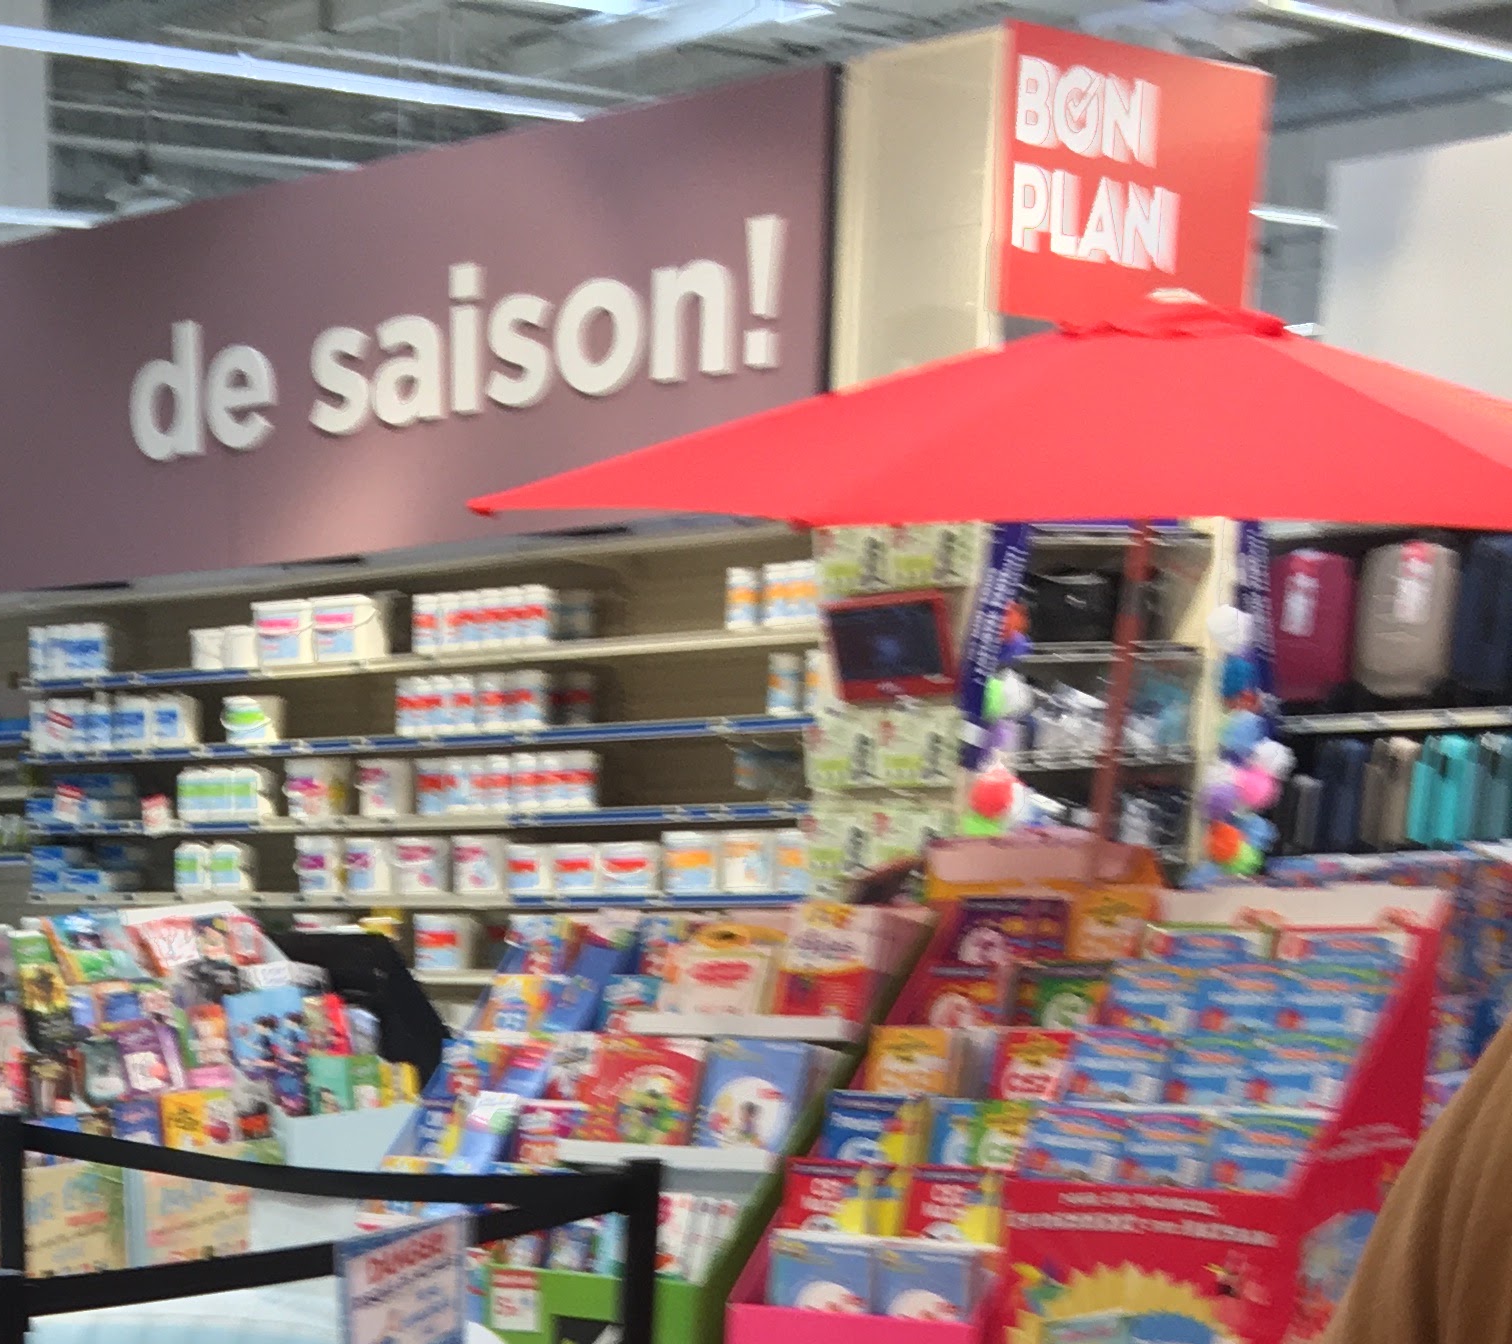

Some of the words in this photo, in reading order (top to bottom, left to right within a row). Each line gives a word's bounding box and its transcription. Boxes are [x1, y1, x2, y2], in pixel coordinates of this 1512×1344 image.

[1016, 54, 1161, 168] BON
[1011, 161, 1182, 275] PLAN
[129, 320, 278, 461] de
[307, 214, 788, 437] saison!
